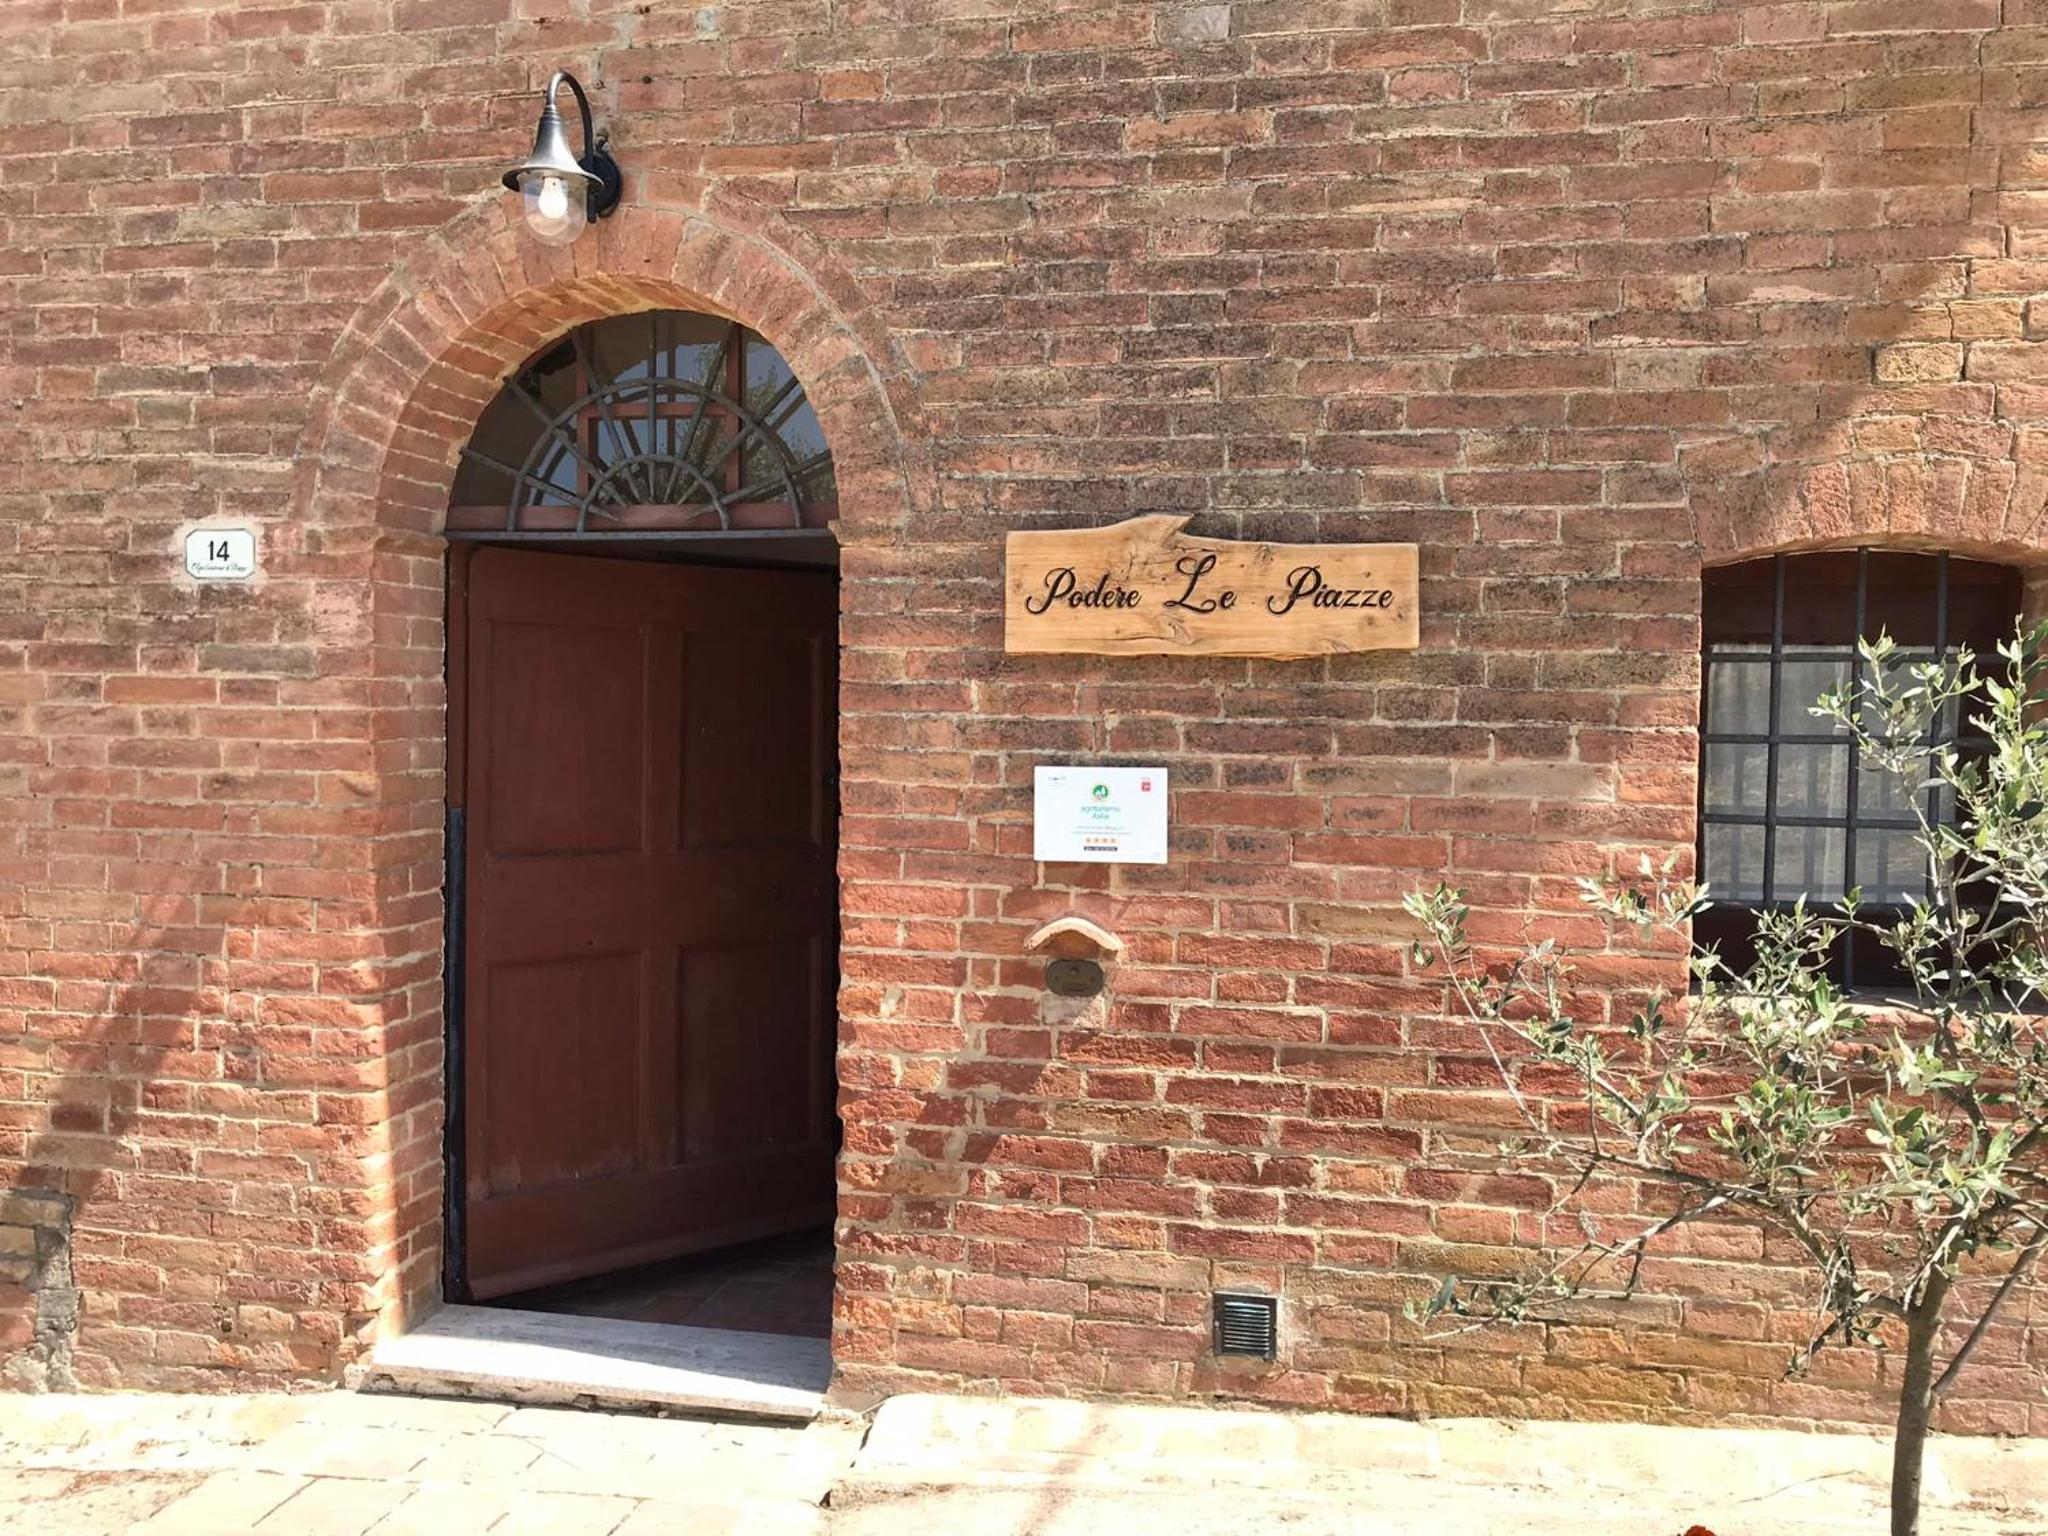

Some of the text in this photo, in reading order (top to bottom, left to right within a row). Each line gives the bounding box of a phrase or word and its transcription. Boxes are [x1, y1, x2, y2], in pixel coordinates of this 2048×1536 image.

[208, 540, 230, 561] 14
[1026, 554, 1394, 615] Podere Le Piazze
